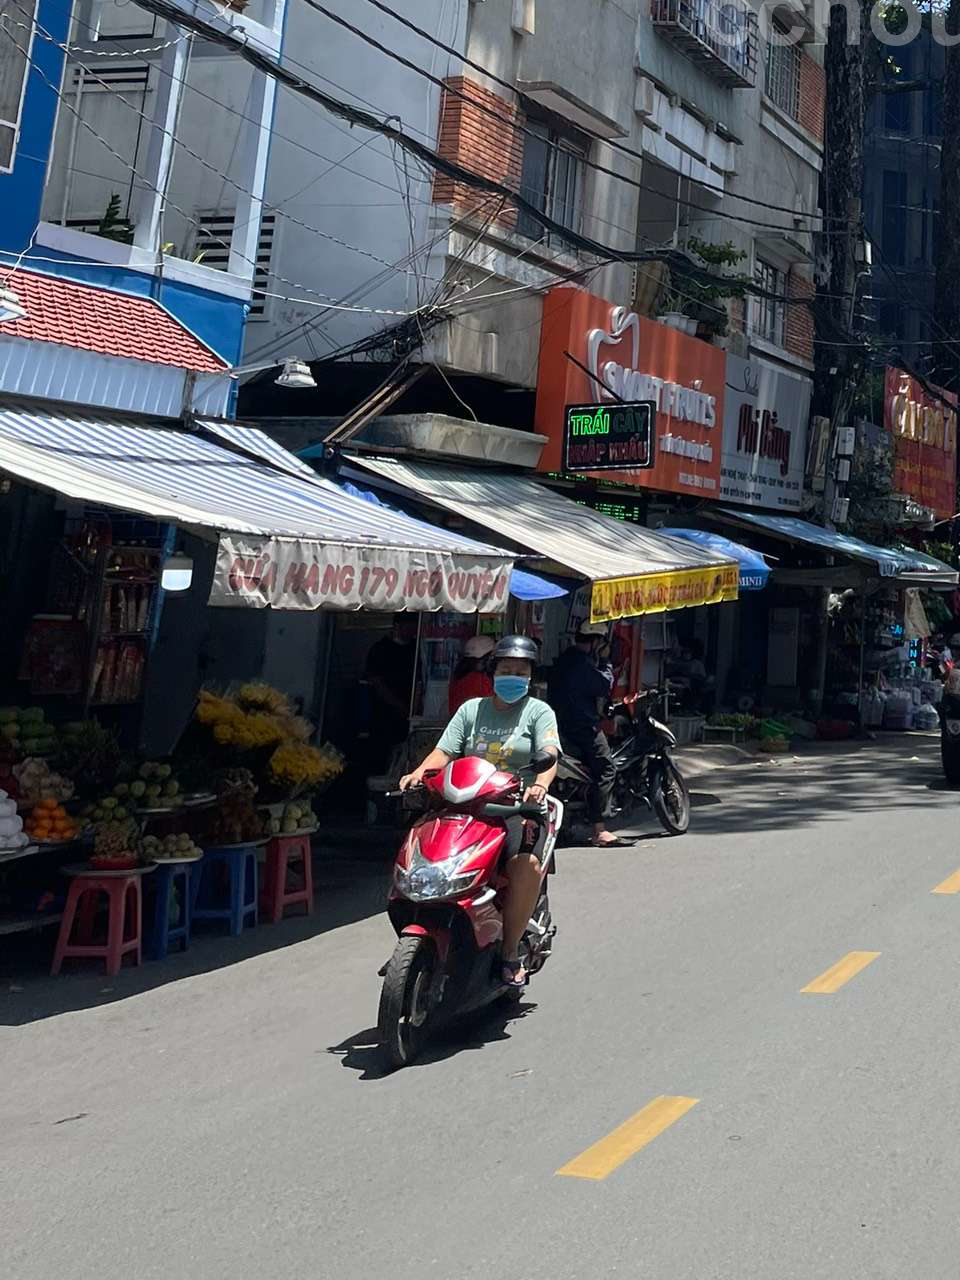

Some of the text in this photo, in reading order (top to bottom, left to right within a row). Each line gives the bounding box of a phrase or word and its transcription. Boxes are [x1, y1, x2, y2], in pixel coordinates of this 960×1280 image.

[570, 408, 647, 435] TRÁI CÂY
[569, 439, 607, 465] NHẬP
[609, 433, 648, 461] KHẨU
[283, 556, 355, 595] HÀNG
[358, 566, 398, 599] 179
